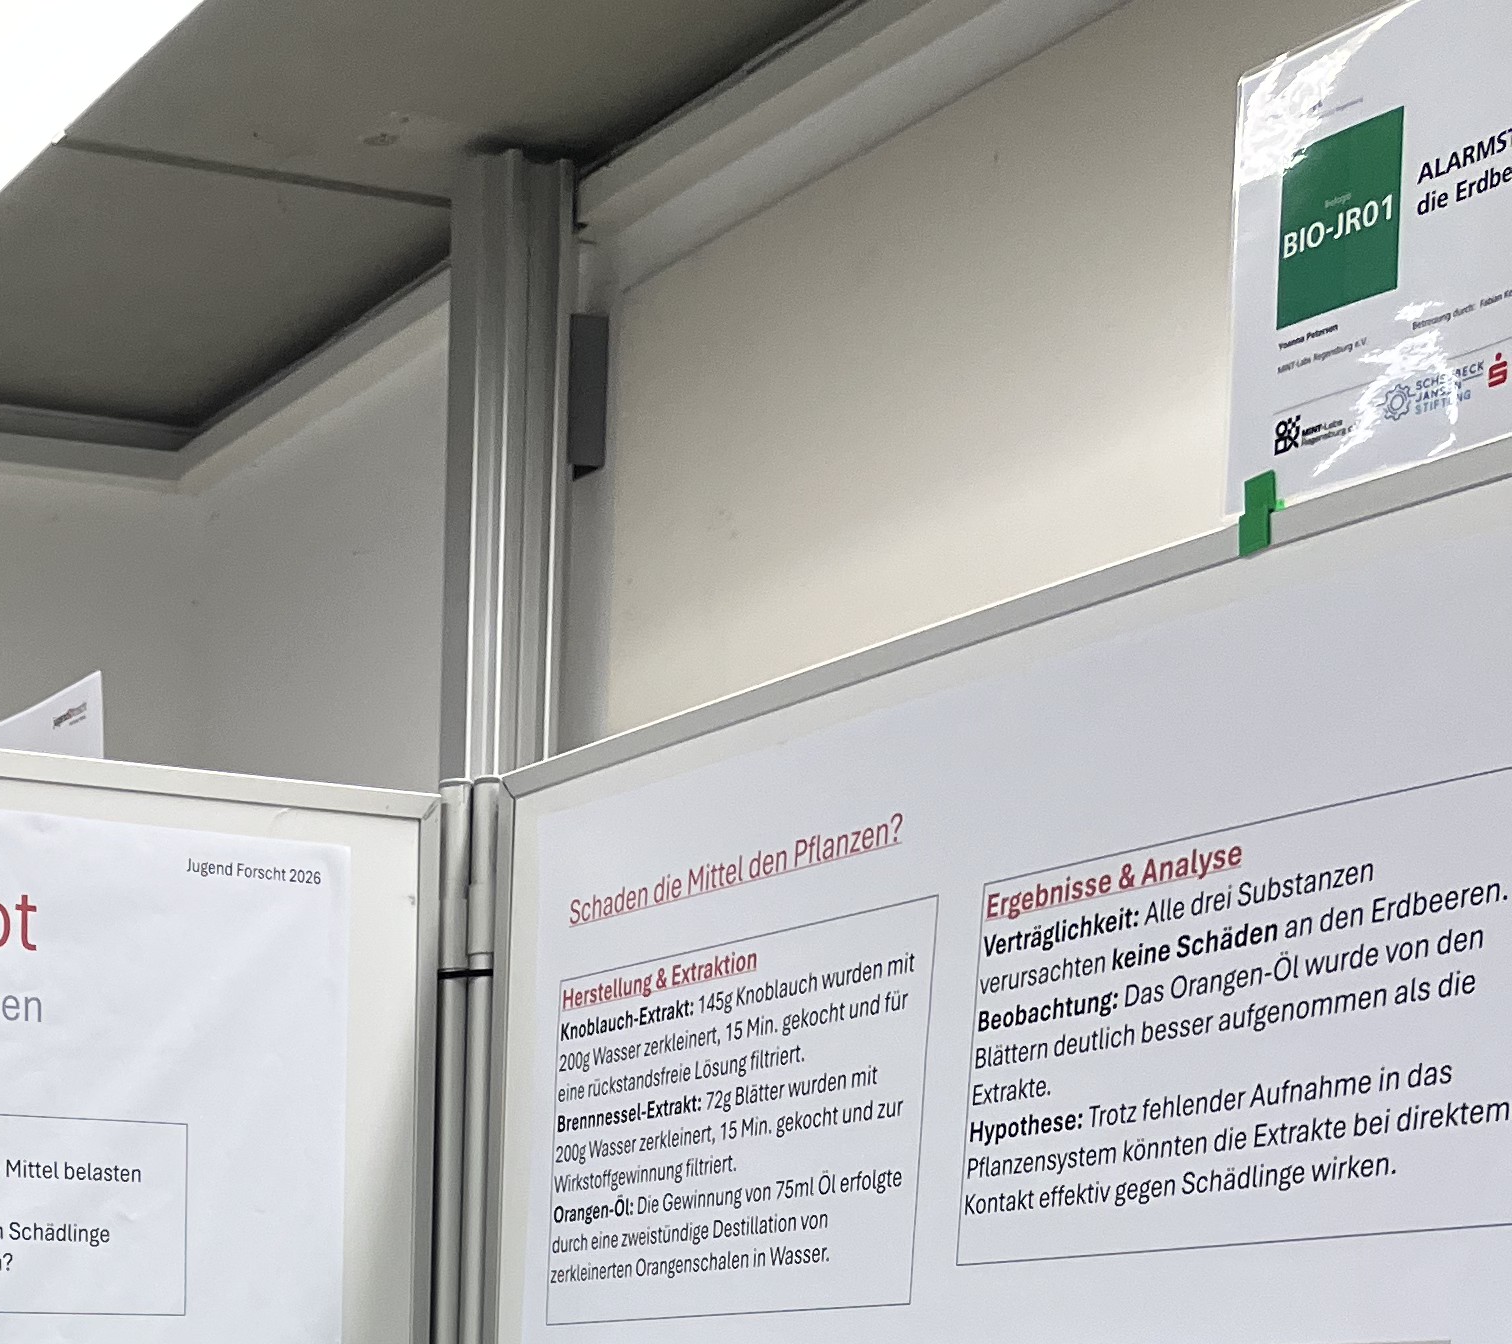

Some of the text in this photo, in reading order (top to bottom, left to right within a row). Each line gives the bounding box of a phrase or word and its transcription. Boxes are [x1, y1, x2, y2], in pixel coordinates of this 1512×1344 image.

[1282, 193, 1394, 260] BIO-JR01
[1416, 190, 1449, 216] die
[185, 857, 322, 885] Jugend Forscht 2026
[569, 813, 903, 923] Schaden die Mittel den Pflanzen?
[986, 845, 1243, 917] Ergebnisse & Analyse
[979, 882, 1509, 995] verursachten keine Schäden an den Erdbeeren.
[559, 952, 757, 1007] Herstellung & Extraktion
[559, 953, 916, 1043] Knoblauch-Extrakt: 145g Knoblauch wurden mit
[971, 1077, 1051, 1107] Extrakte.
[5, 1159, 60, 1180] Mittel
[63, 1161, 142, 1183] belasten
[963, 1153, 1397, 1217] Kontakt effektiv gegen Schädlinge wirken.
